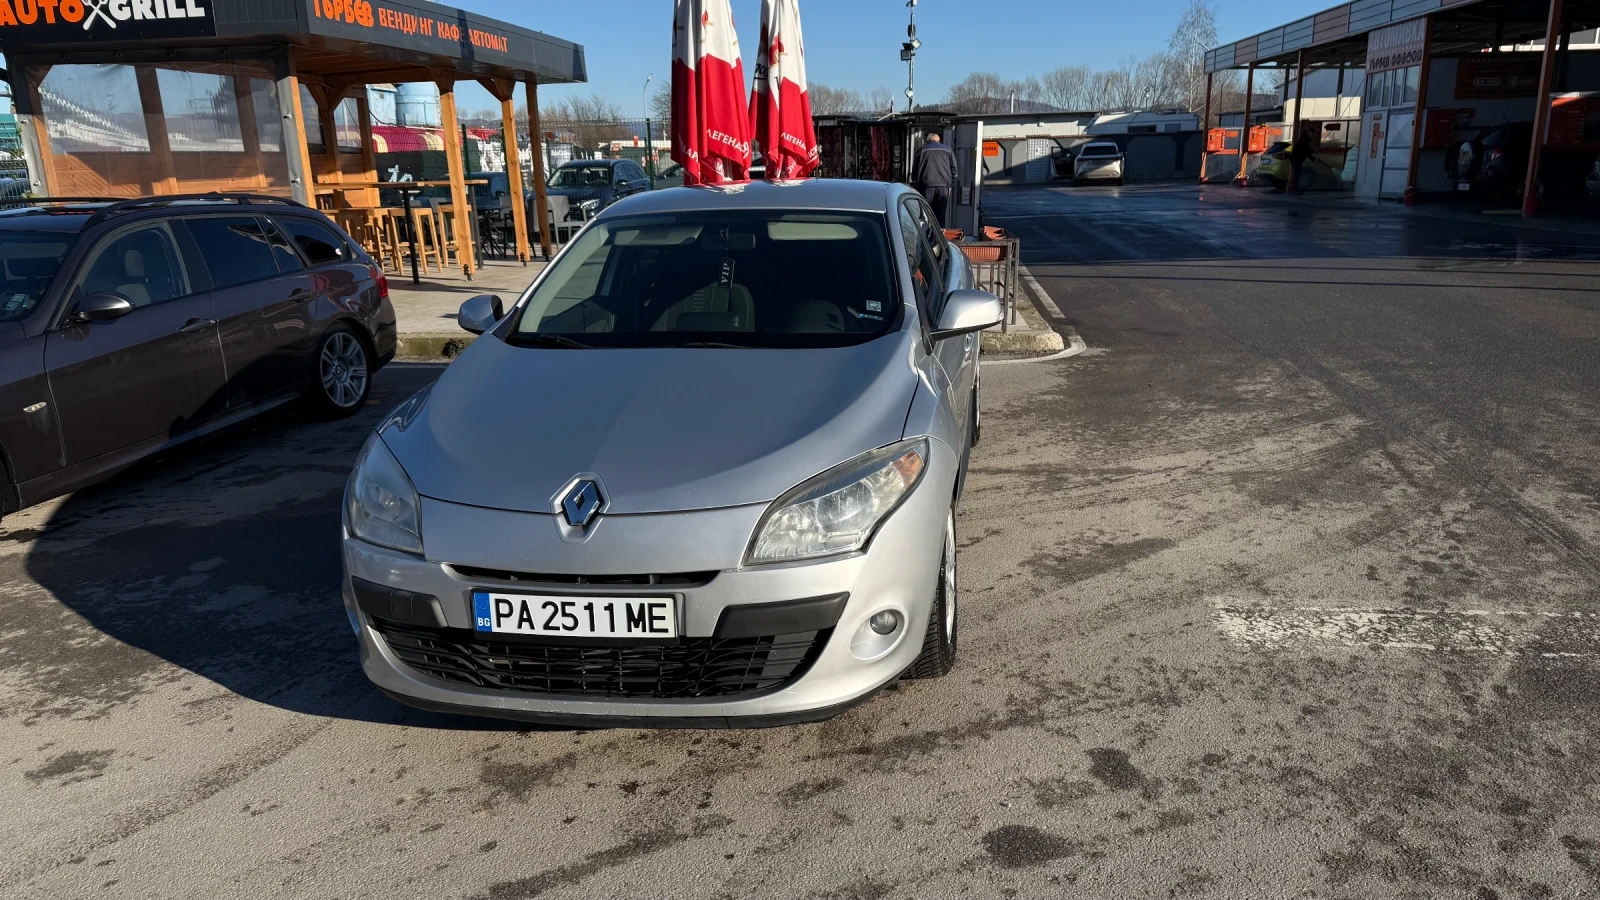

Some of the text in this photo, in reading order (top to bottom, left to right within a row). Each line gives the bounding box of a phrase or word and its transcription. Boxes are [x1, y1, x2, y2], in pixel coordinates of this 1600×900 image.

[0, 0, 206, 26] AUTO GRILL
[378, 7, 434, 36] ВЕНДИНГ
[437, 20, 466, 43] КАФЕ
[468, 28, 509, 53] АВТОМАТ
[1368, 19, 1425, 52] АВТОМИВКА
[721, 262, 730, 284] VIP
[478, 618, 491, 626] BG
